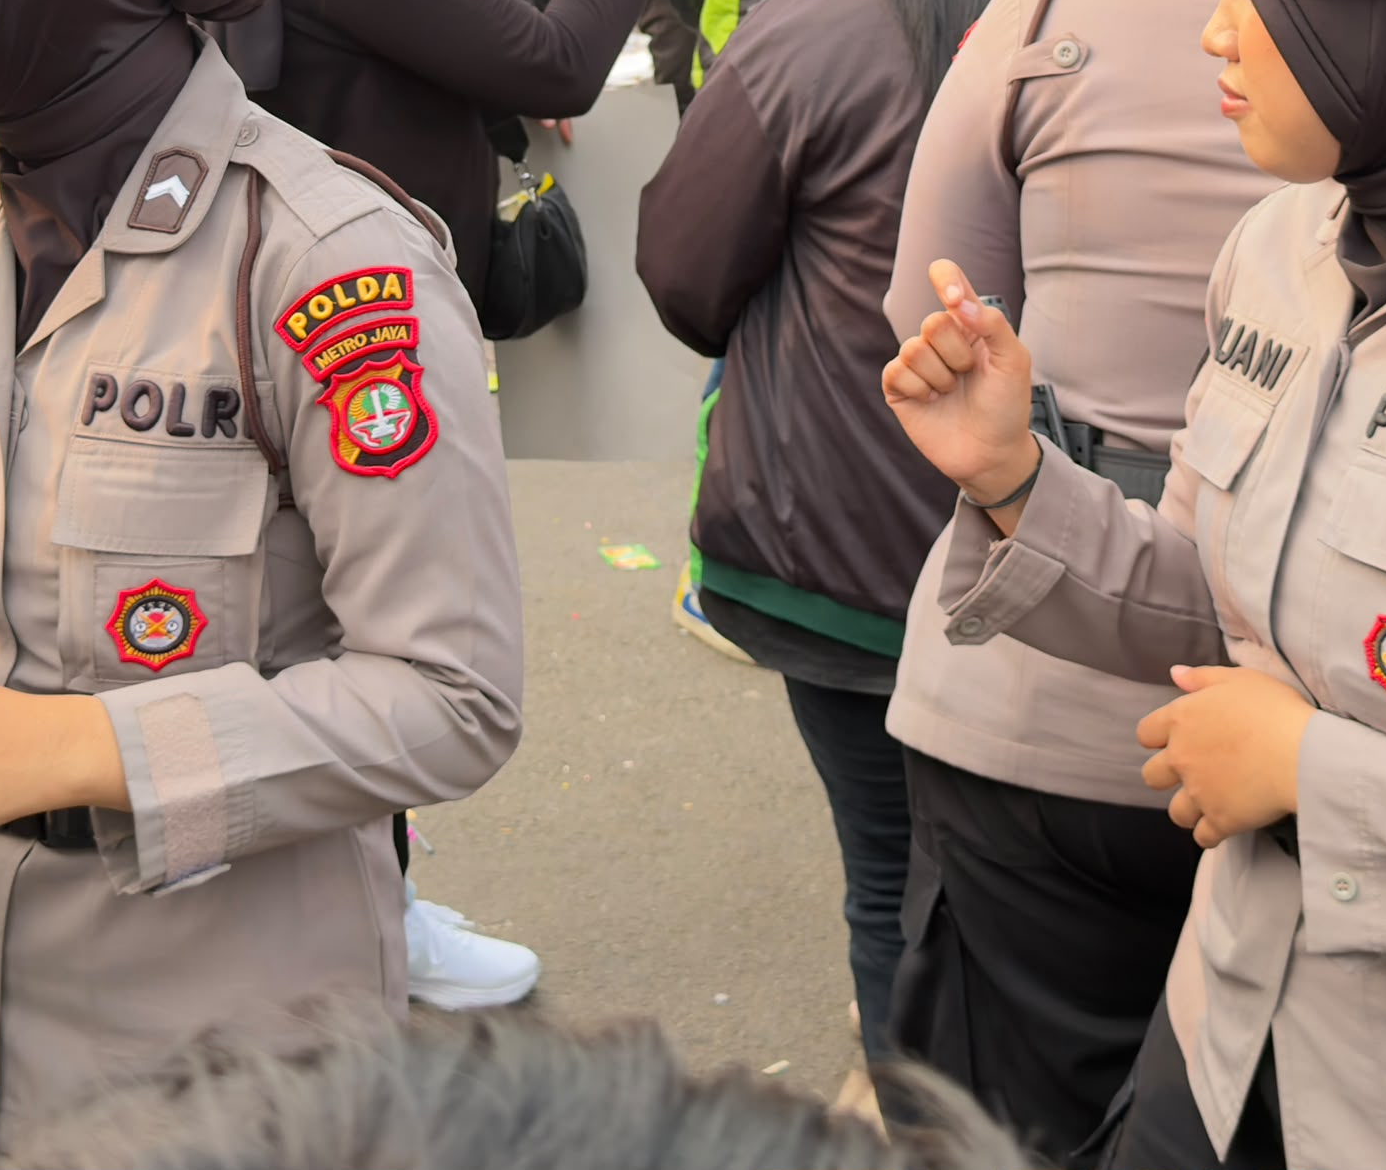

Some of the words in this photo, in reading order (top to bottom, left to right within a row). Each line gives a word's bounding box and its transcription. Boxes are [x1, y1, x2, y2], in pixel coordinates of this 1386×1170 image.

[287, 273, 403, 340] POLDA
[315, 333, 367, 370] METRO
[370, 324, 409, 345] JAYA
